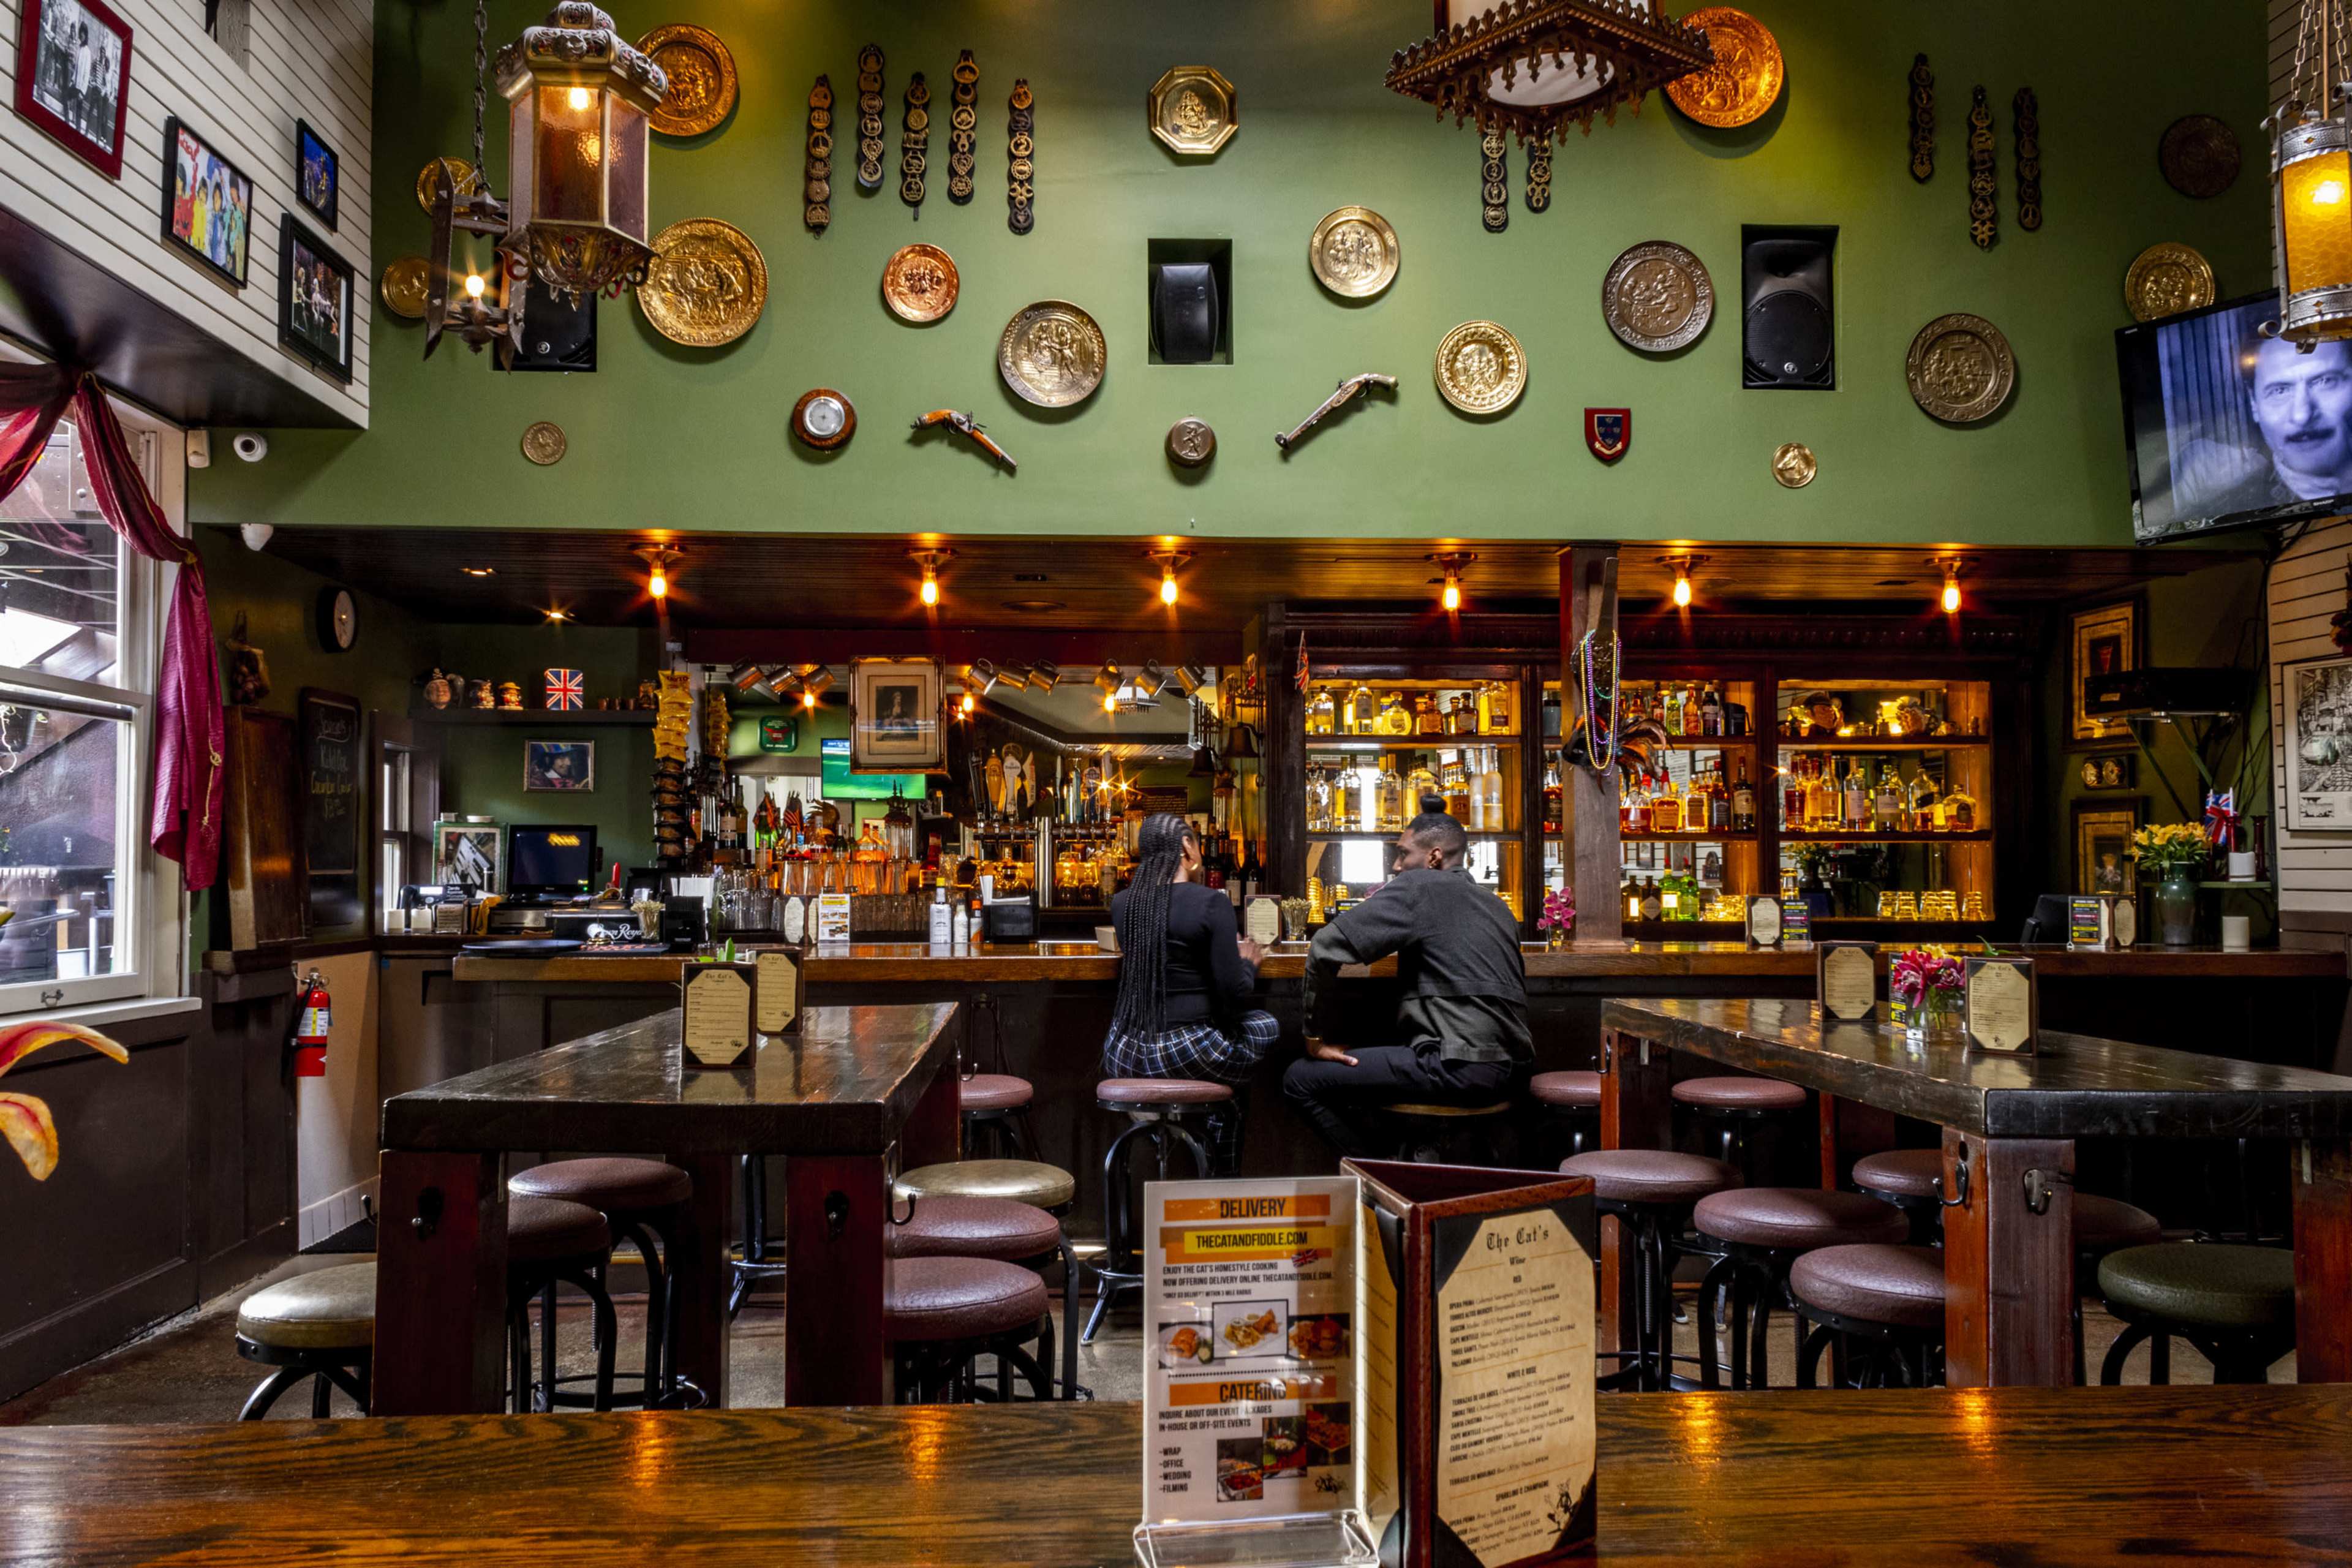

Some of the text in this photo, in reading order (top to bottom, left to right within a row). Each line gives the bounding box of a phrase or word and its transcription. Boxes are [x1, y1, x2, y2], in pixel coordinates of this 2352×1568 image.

[1219, 1197, 1286, 1218] DELIVERY
[1196, 1232, 1308, 1249] THECATANDFIDDLE.COM
[1487, 1224, 1549, 1254] The Cat's
[1163, 1266, 1181, 1275] ENJOY
[1196, 1264, 1213, 1273] CAT'S
[1215, 1263, 1251, 1272] HOMESTYLE
[1252, 1262, 1278, 1270] COOKING
[1163, 1278, 1177, 1286] NOW
[1178, 1276, 1208, 1286] OFFERING
[1210, 1275, 1238, 1284] DELIVERY
[1240, 1274, 1261, 1283] ONLINE
[1219, 1381, 1287, 1403] CATERING
[1159, 1406, 1272, 1419] INQUIRE ABOUT OUR EVENT AKAGES
[1159, 1419, 1251, 1432] IN-HOUSE OR OFF-SITE EVENTS
[1159, 1446, 1182, 1456] -WRAP
[1159, 1458, 1183, 1469] -OFFICE
[1159, 1471, 1192, 1480] -WEDDING
[1159, 1483, 1188, 1493] -FILMING
